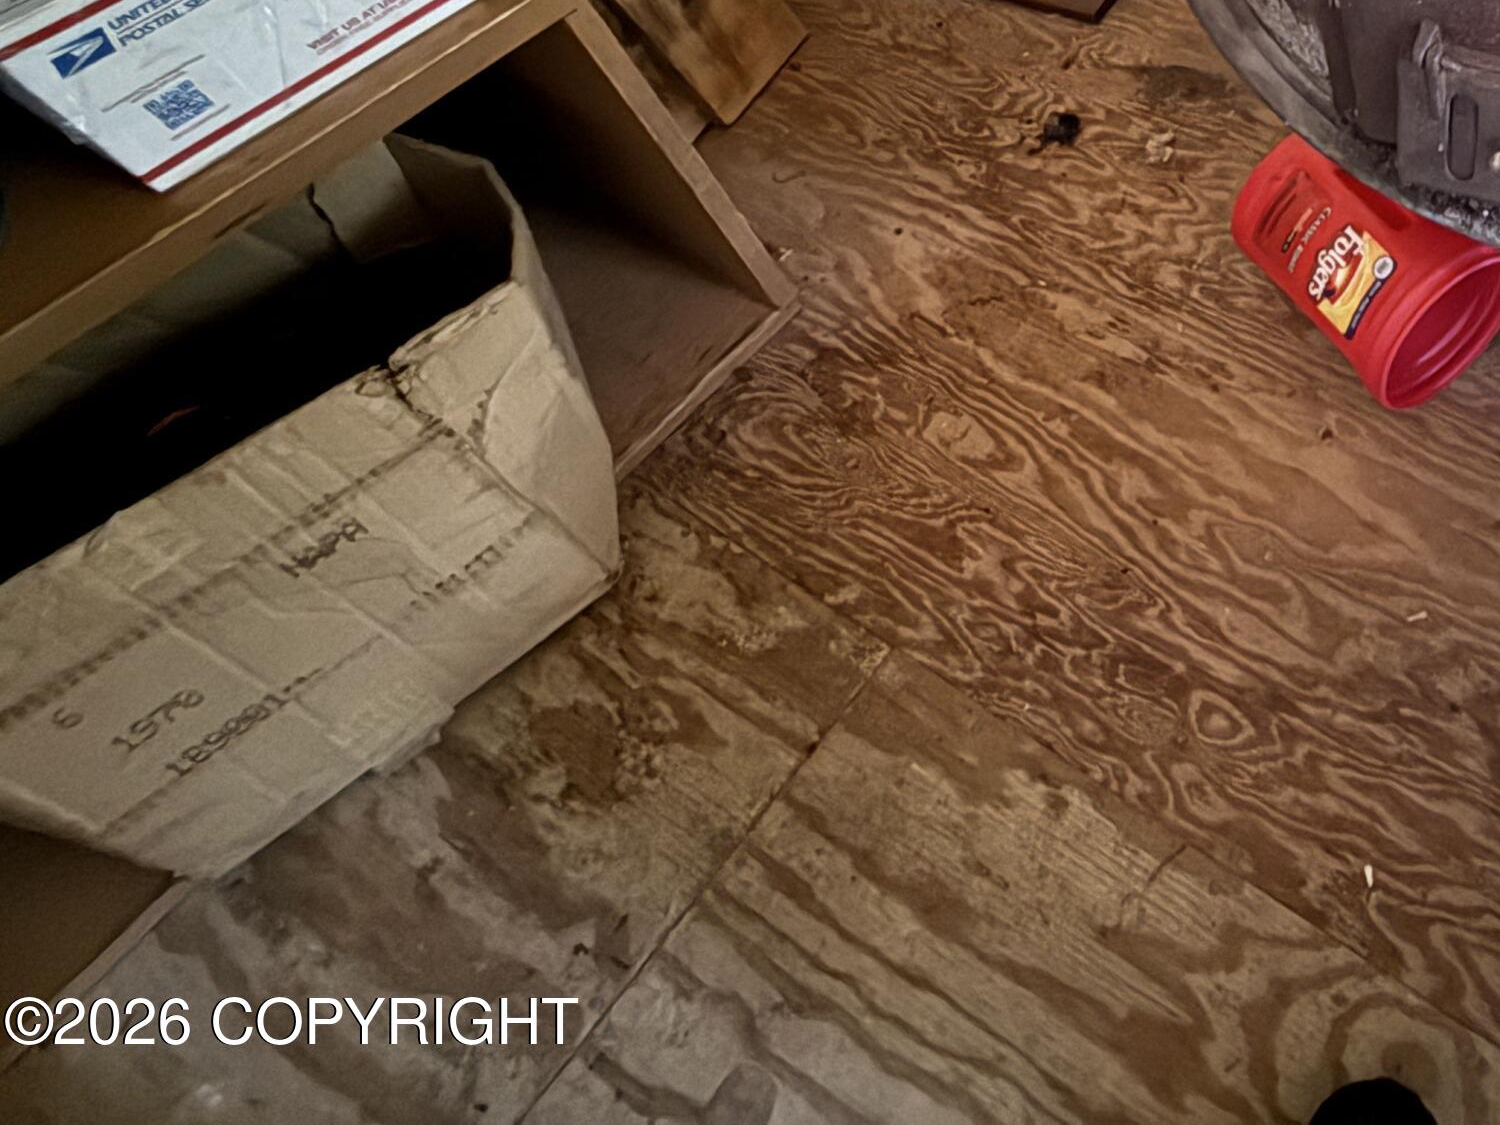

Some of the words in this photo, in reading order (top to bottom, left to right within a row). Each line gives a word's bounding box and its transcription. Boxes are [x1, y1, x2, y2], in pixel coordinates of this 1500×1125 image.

[117, 9, 184, 47] POSTAL
[306, 27, 341, 50] VISIT
[341, 17, 361, 35] US
[361, 3, 379, 22] AT
[1309, 225, 1365, 301] Folgers
